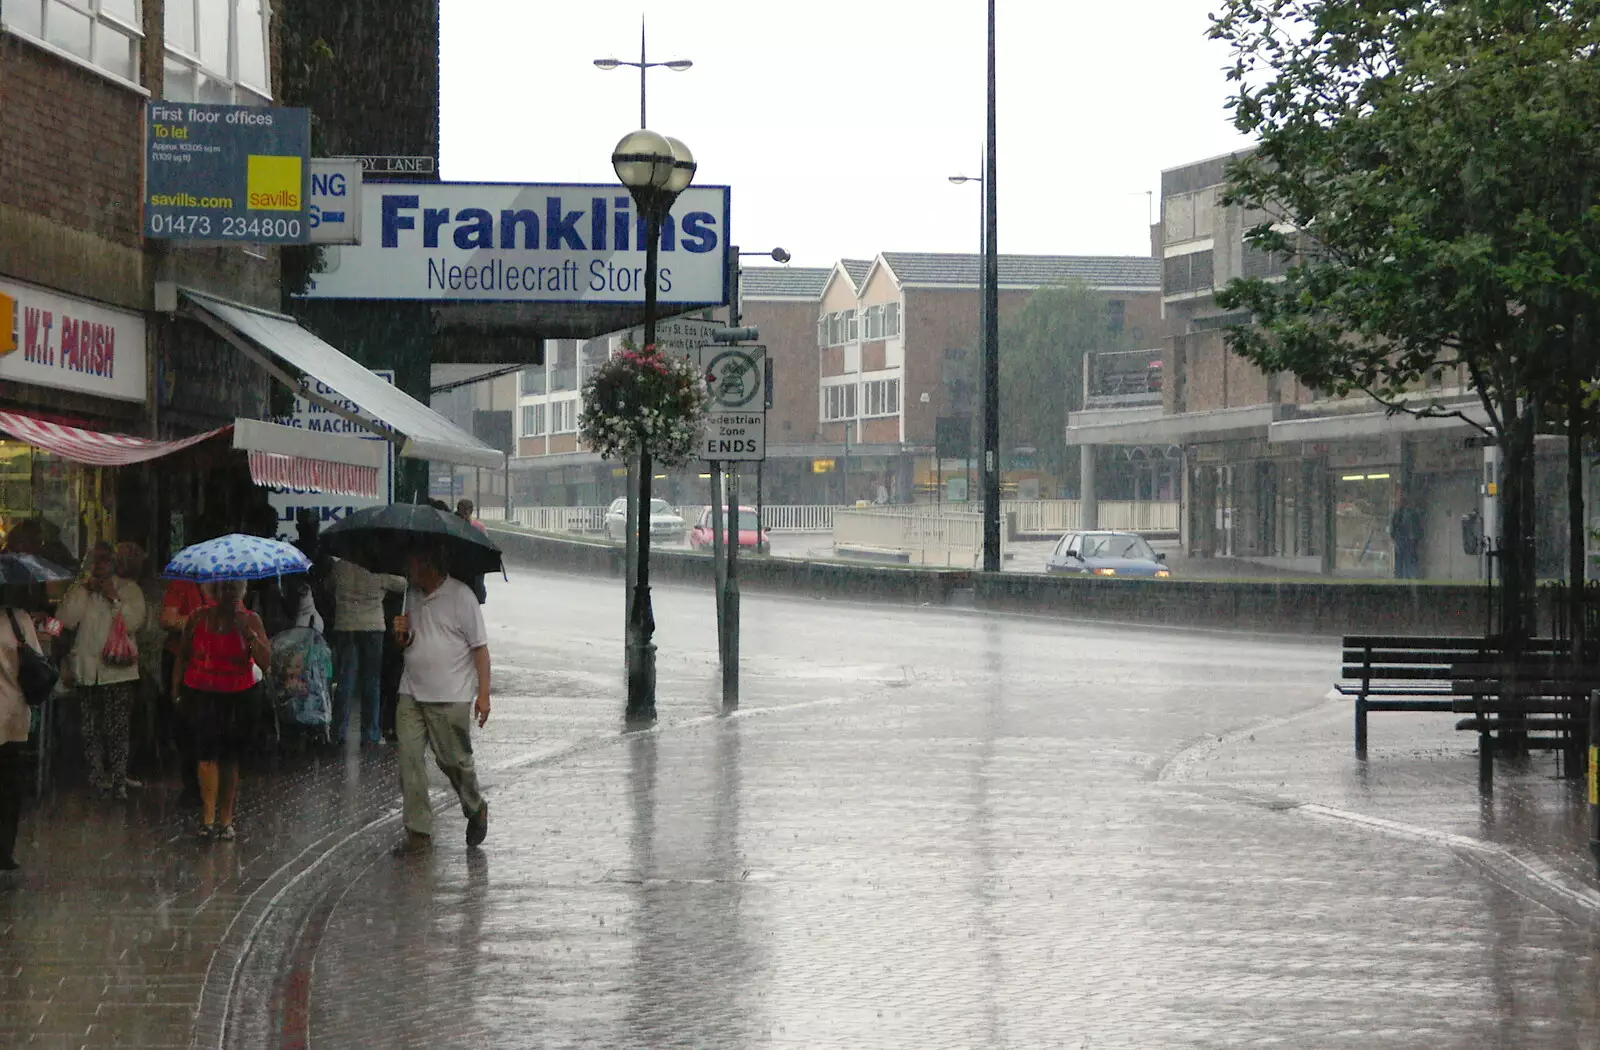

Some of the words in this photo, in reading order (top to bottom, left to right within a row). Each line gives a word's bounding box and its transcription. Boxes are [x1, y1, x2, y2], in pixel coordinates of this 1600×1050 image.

[152, 107, 183, 121] First
[188, 109, 220, 123] floor
[225, 111, 273, 125] offices
[152, 124, 169, 137] To
[171, 125, 188, 139] let
[387, 158, 423, 171] LANE
[150, 193, 232, 208] savills.com
[249, 190, 298, 208] savills
[151, 214, 211, 235] 01473
[221, 217, 300, 238] 234800
[380, 195, 718, 253] Franklins
[427, 258, 579, 292] Needlecraft
[589, 259, 672, 292] Stors
[24, 306, 54, 366] W.T.
[60, 315, 115, 378] PARISH
[708, 415, 761, 425] edestrian
[719, 427, 746, 436] Zone
[707, 439, 757, 453] ENDS
[277, 506, 354, 521] JKI
